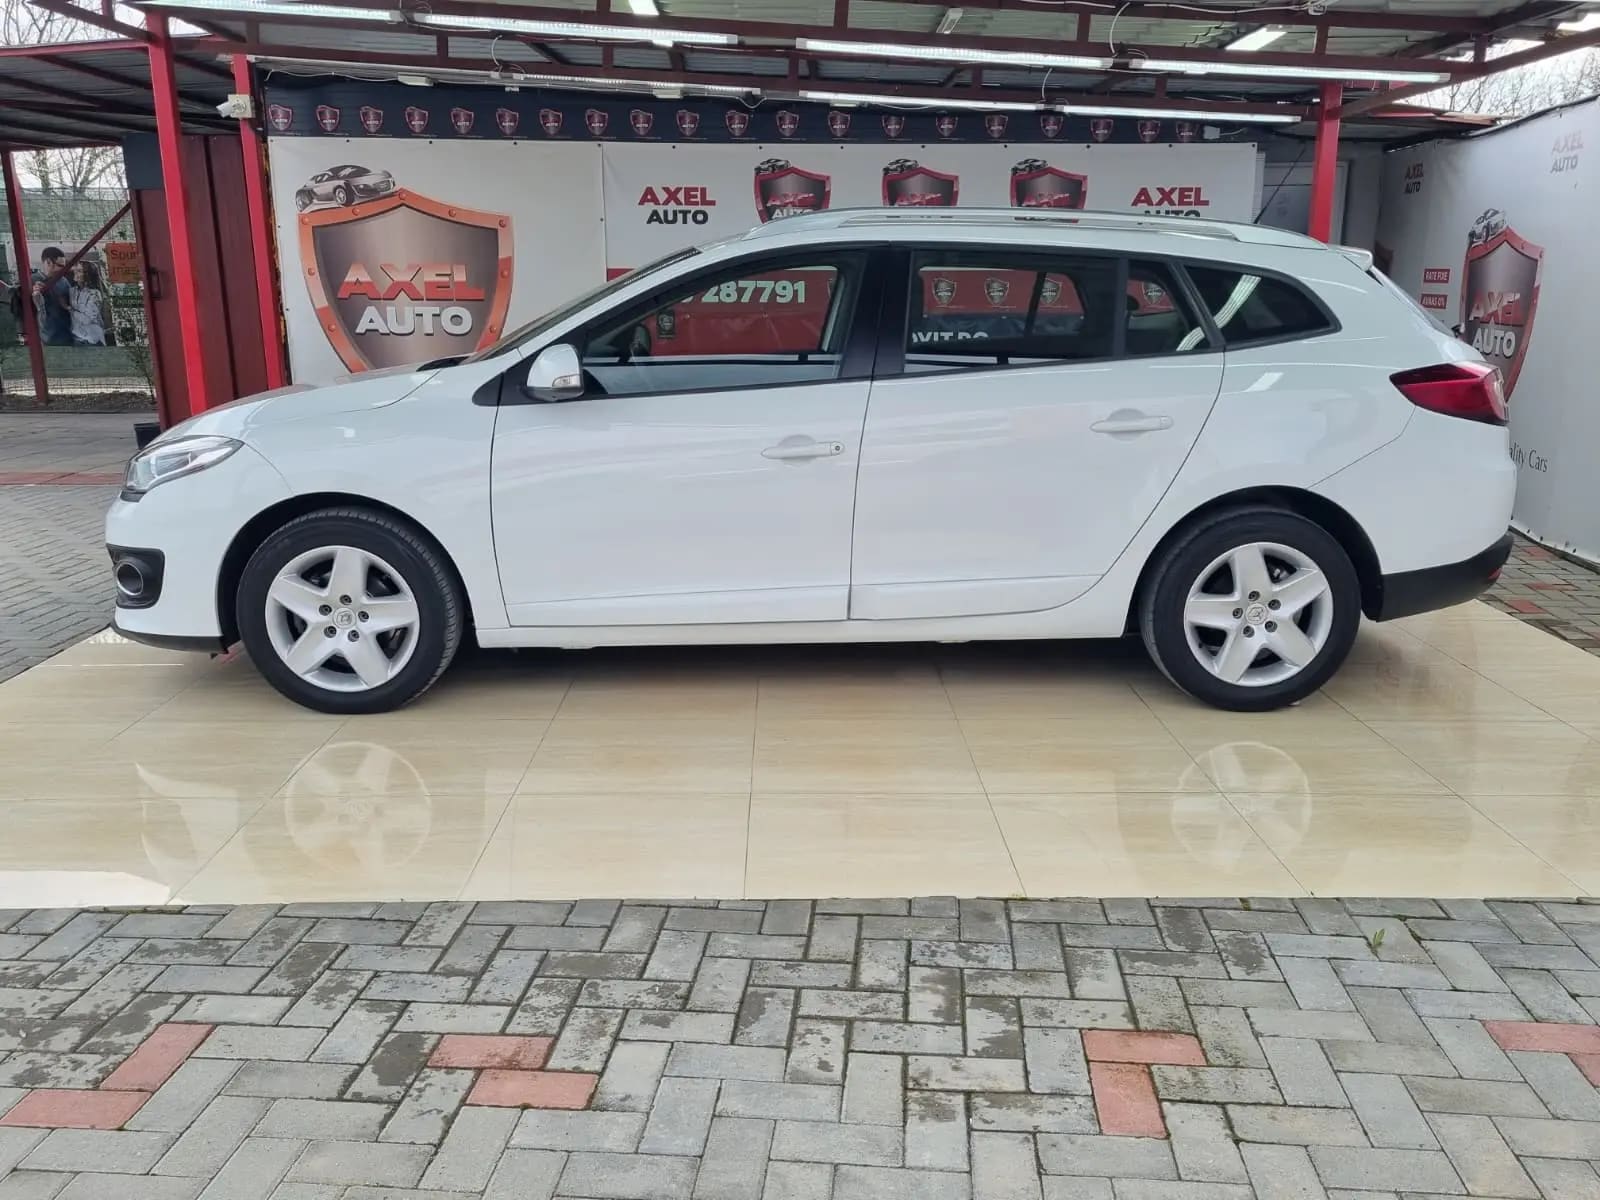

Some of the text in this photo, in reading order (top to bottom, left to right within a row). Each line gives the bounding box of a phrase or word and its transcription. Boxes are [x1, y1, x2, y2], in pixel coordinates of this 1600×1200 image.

[1552, 131, 1584, 154] AXEL
[1405, 161, 1424, 180] AXEL
[1551, 155, 1578, 174] AUTO
[638, 186, 716, 206] AXEL
[1131, 187, 1210, 206] AXEL
[1404, 181, 1421, 194] AUTO
[646, 209, 709, 225] AUTO
[337, 263, 485, 301] AXEL
[701, 280, 806, 303] 287791
[355, 305, 473, 336] AUTO
[1468, 291, 1524, 327] AXEL
[1472, 327, 1516, 358] AUTO
[1529, 449, 1548, 473] Cars
